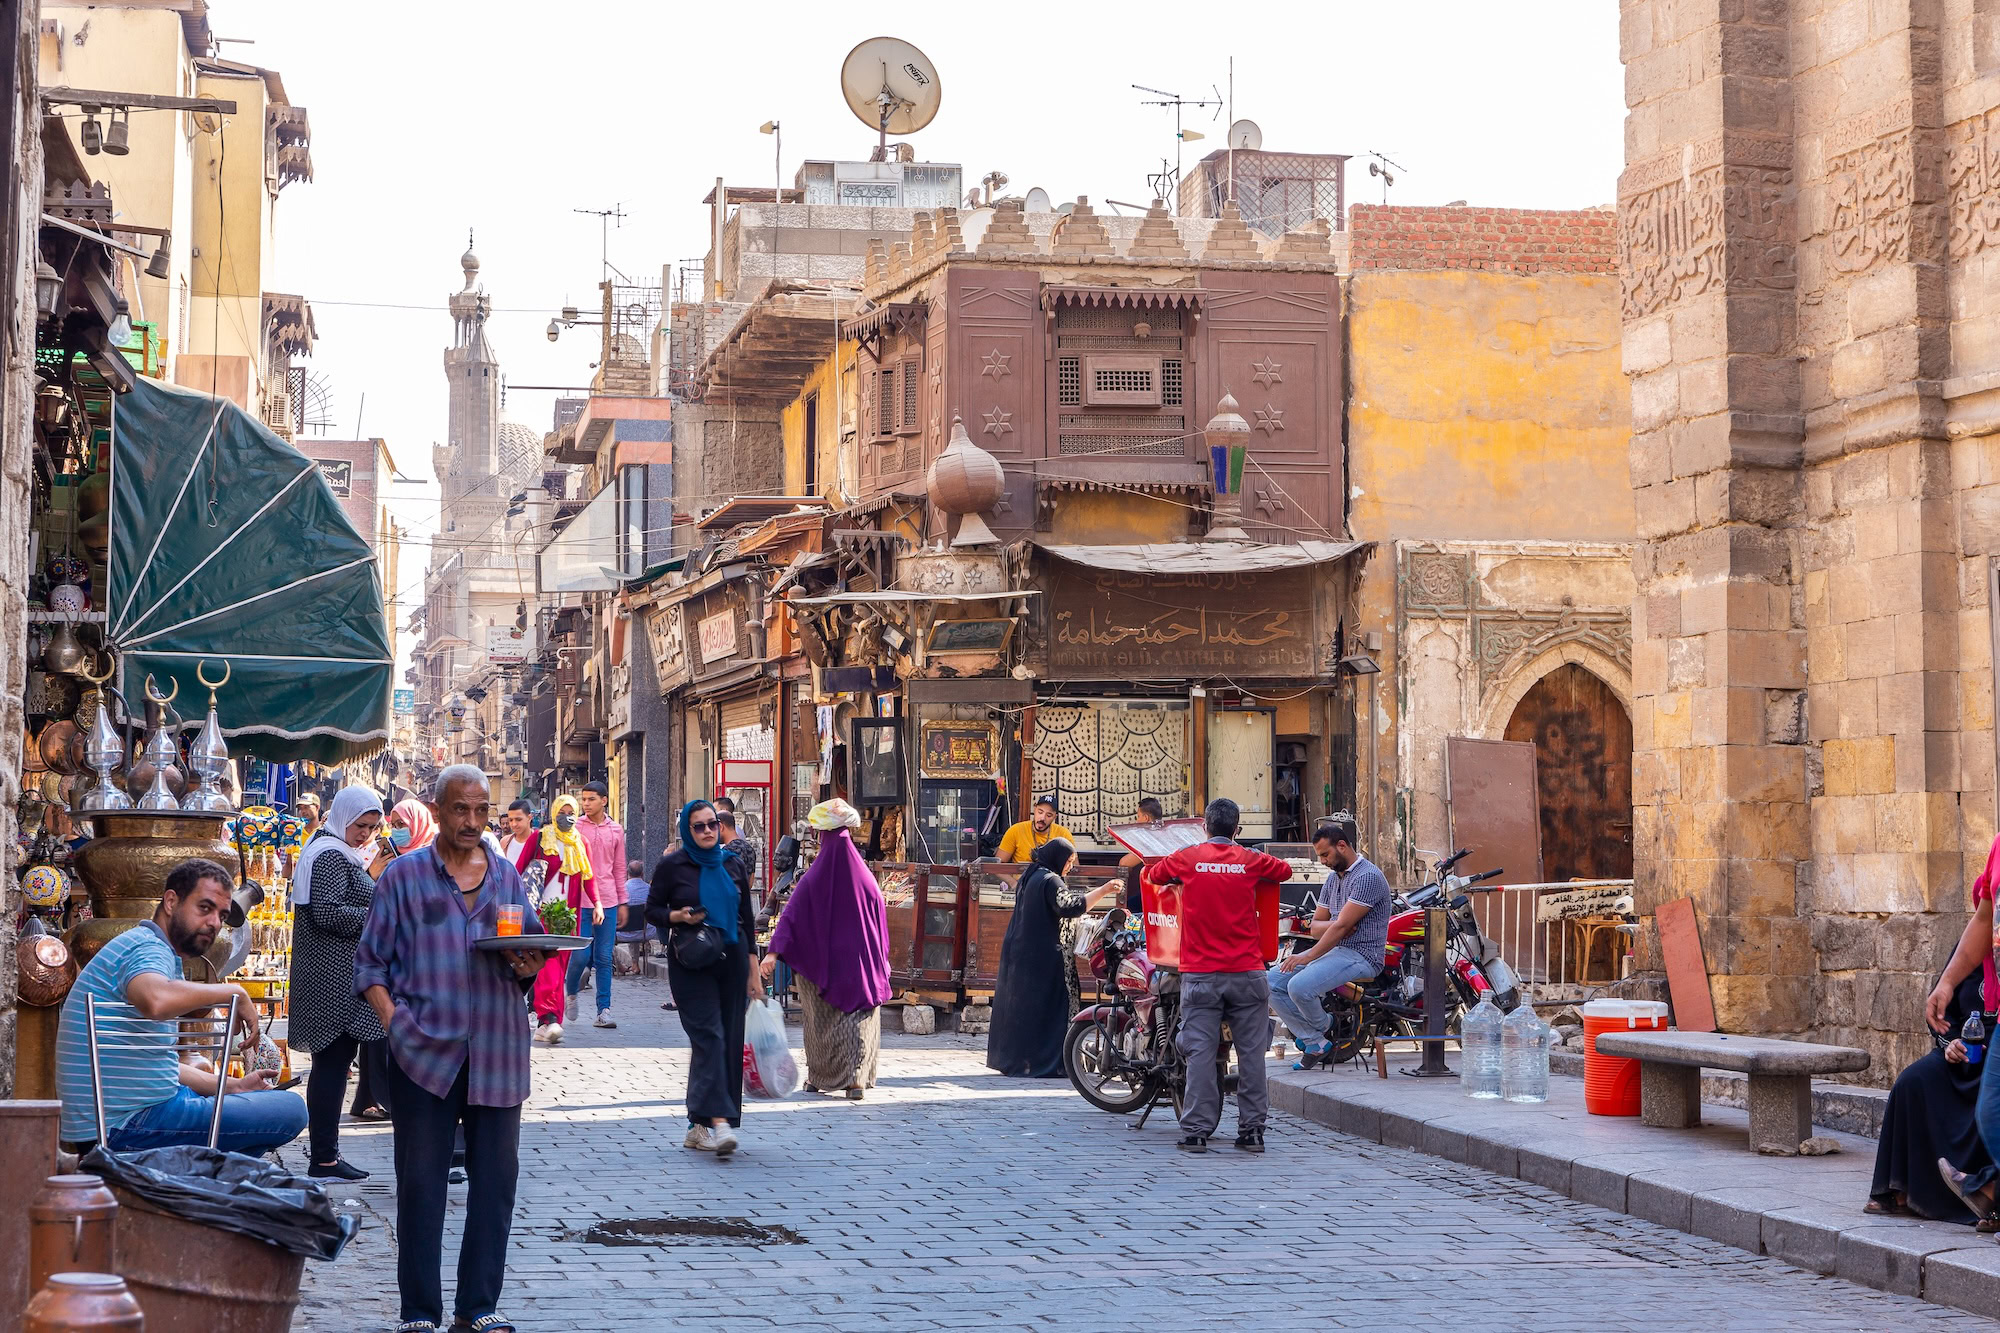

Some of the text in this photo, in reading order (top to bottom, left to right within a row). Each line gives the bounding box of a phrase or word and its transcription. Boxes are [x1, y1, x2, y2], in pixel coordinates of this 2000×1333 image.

[1056, 606, 1145, 646] حمامة
[1208, 606, 1295, 646] محمد
[1194, 861, 1247, 875] aramex
[1147, 911, 1179, 930] aramex
